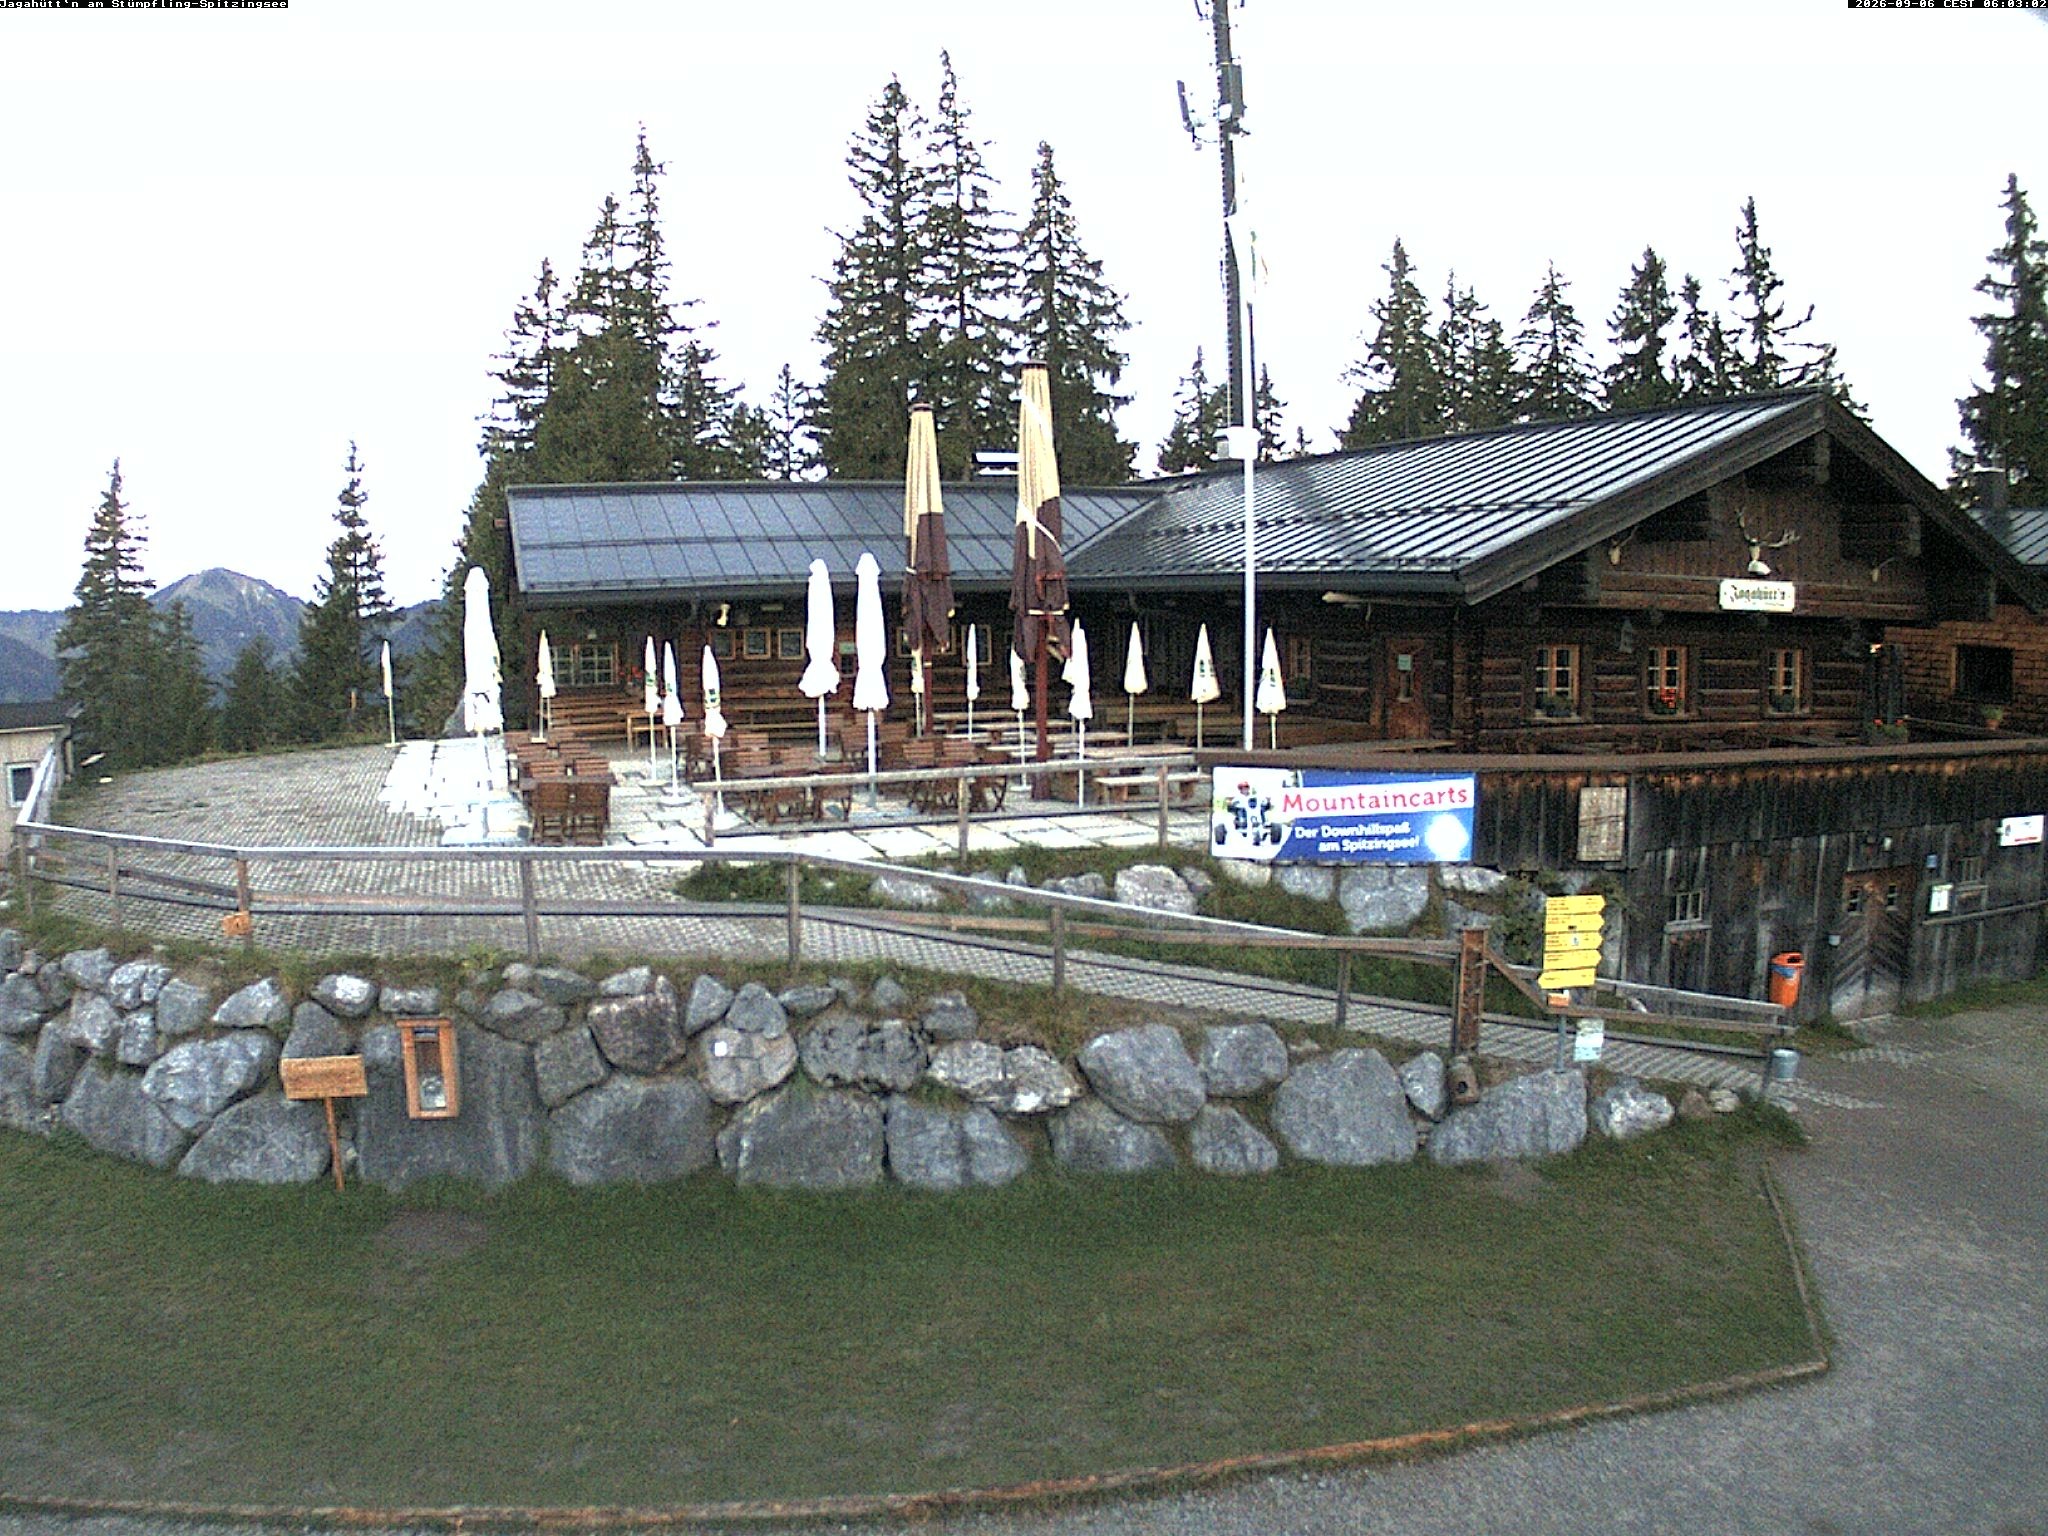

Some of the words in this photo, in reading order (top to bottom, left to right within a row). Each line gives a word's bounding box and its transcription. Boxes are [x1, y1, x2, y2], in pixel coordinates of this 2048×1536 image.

[1282, 787, 1468, 813] Mountaincarts
[1295, 827, 1318, 838] Der
[1319, 842, 1340, 852] am
